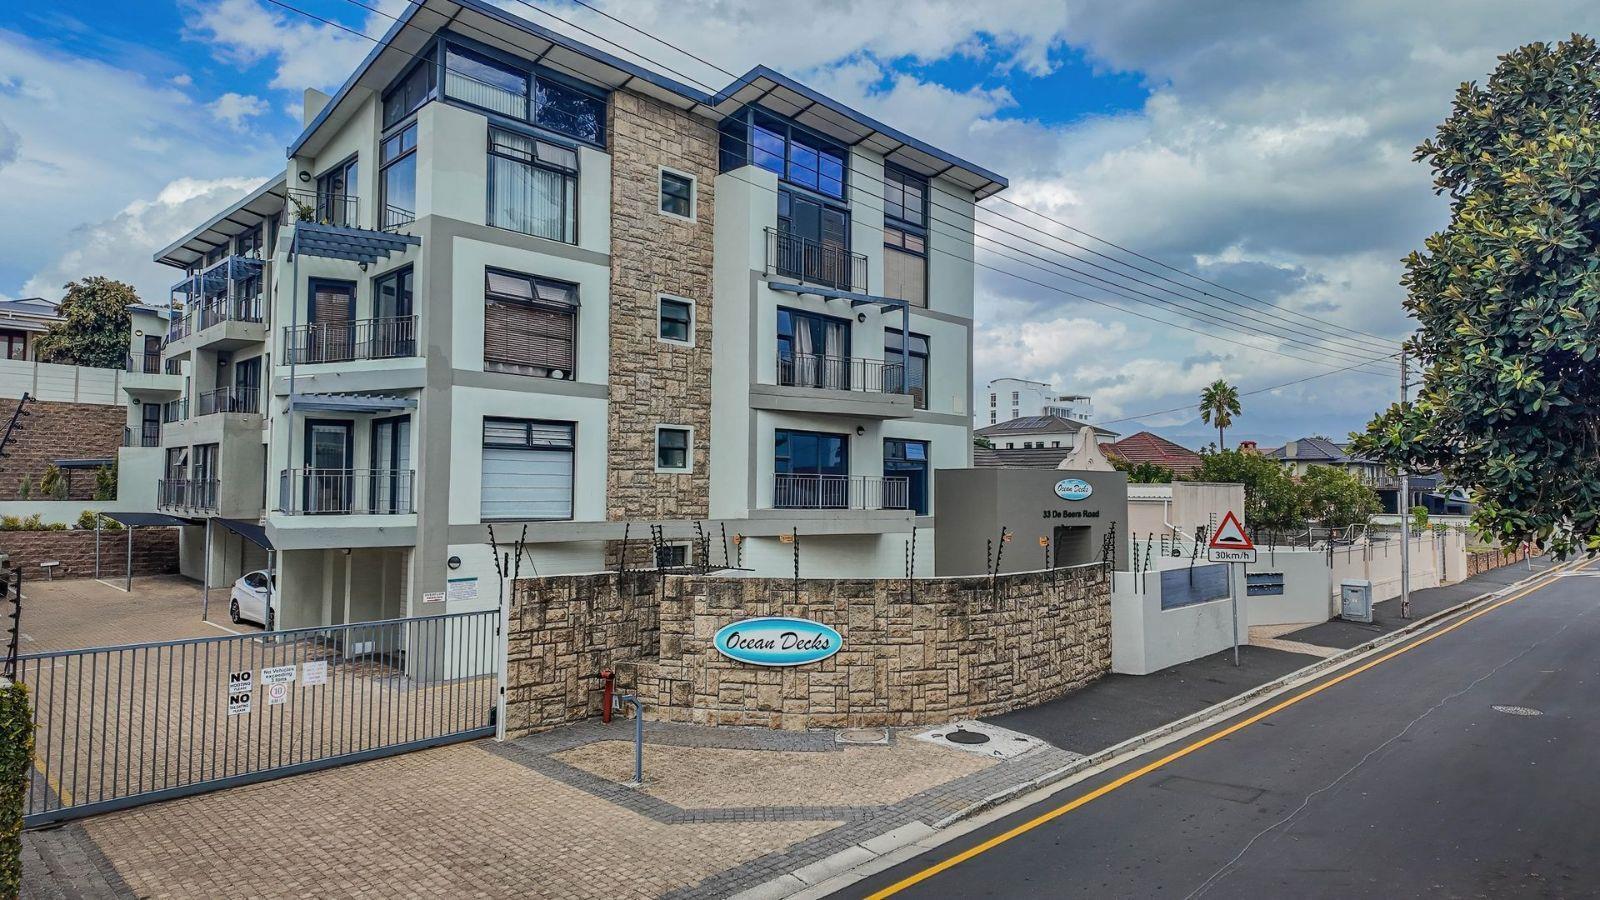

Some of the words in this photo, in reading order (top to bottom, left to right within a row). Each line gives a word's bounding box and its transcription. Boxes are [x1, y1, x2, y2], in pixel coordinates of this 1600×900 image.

[1057, 484, 1073, 492] Ocean
[1074, 484, 1089, 493] Decks
[1043, 510, 1051, 518] 33
[1052, 510, 1061, 518] De
[1063, 510, 1082, 518] Beers
[1083, 510, 1100, 518] Road
[726, 631, 775, 650] Ocean
[780, 632, 831, 650] Decks
[231, 672, 251, 682] NO
[274, 687, 283, 695] 10
[230, 694, 250, 705] NO
